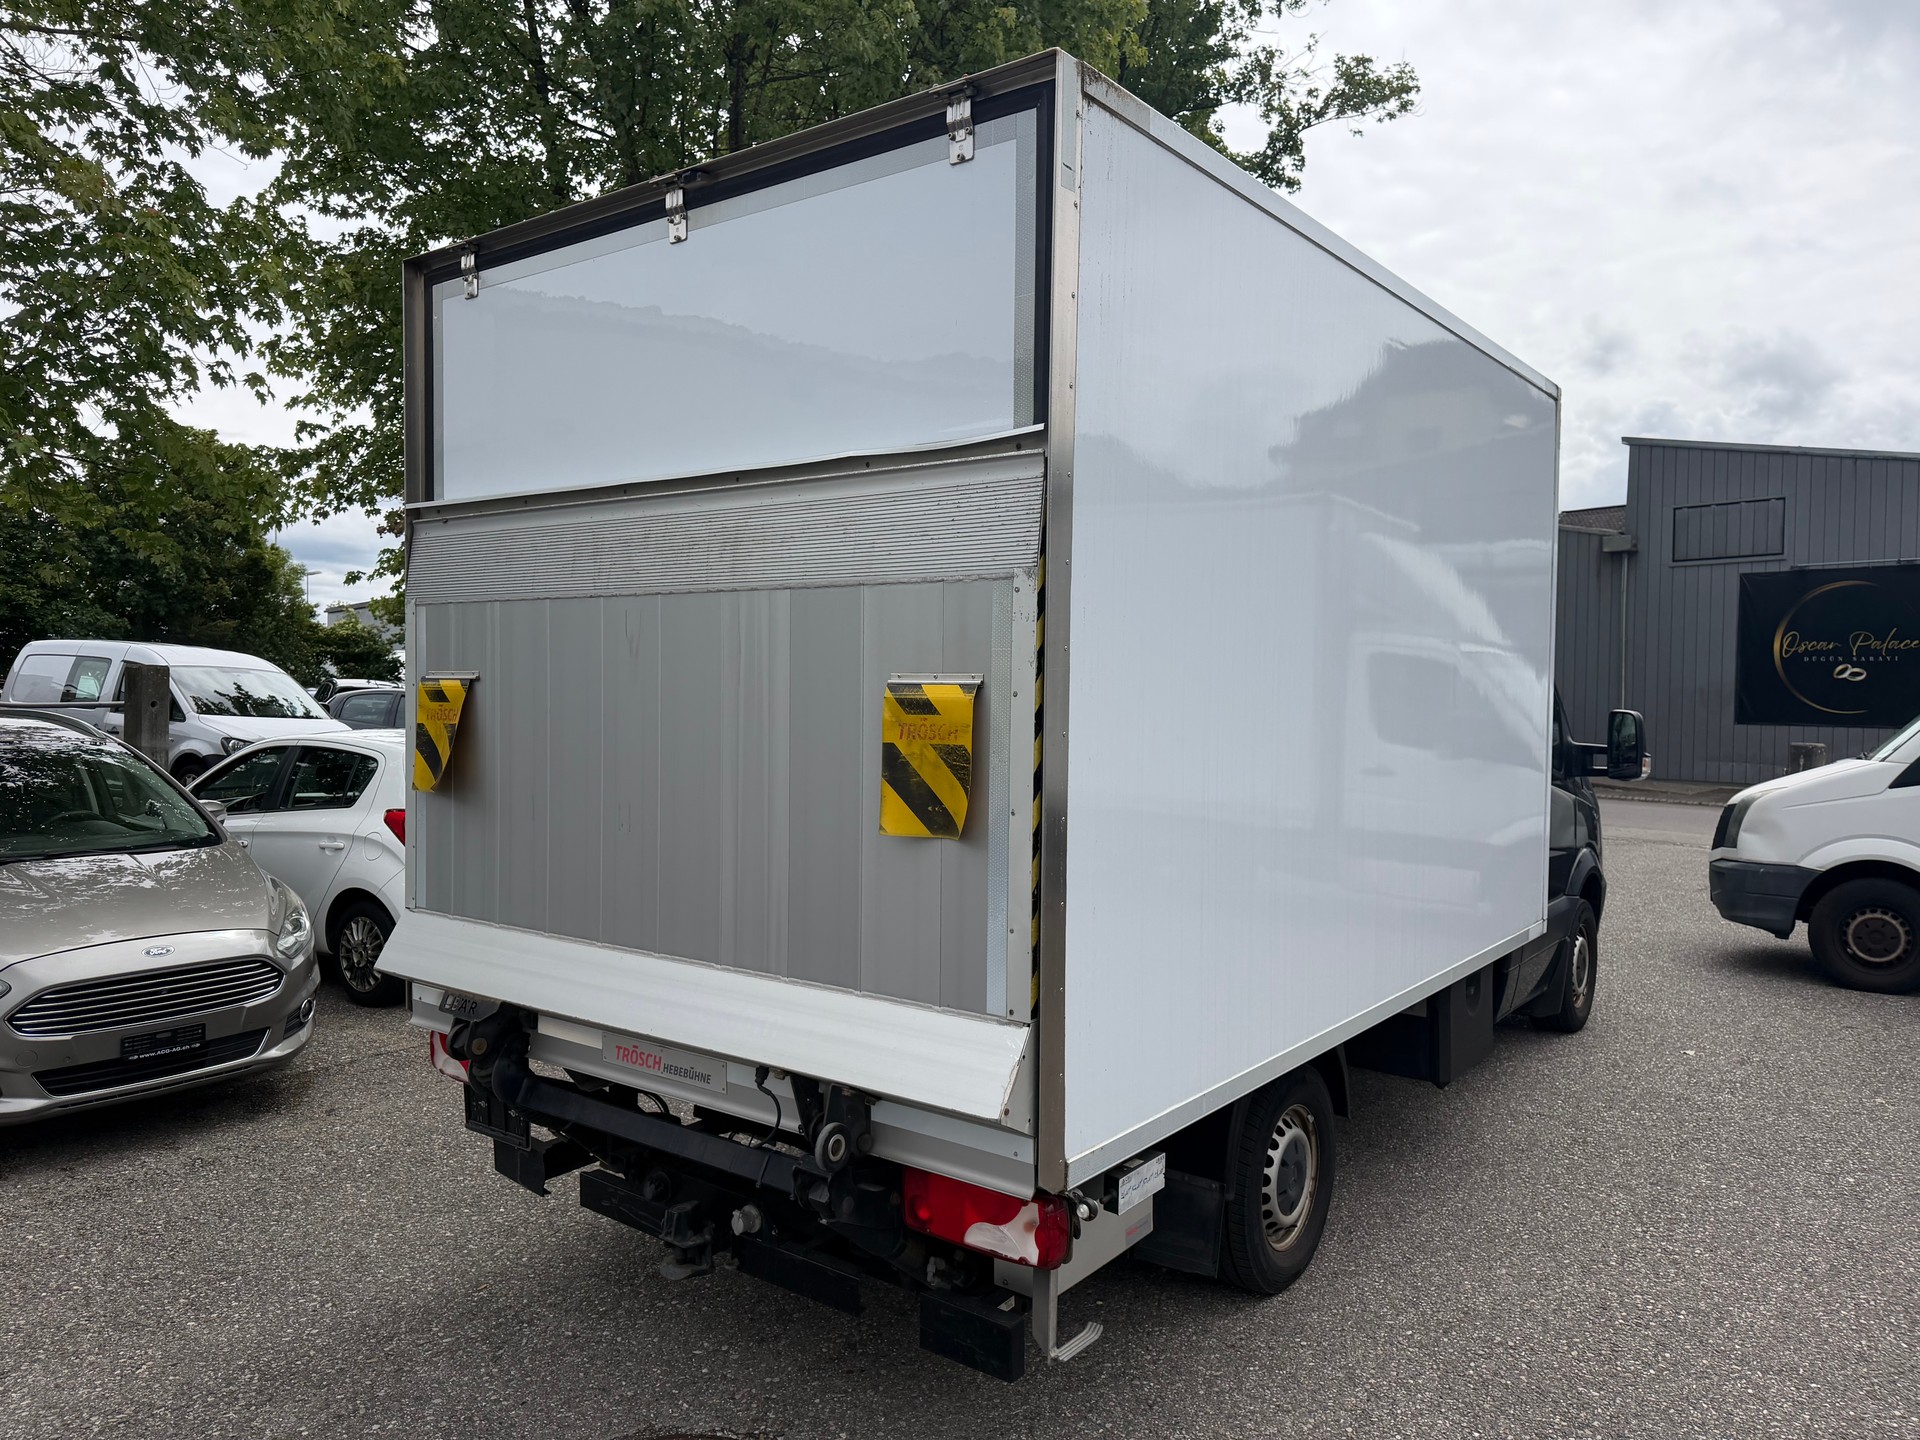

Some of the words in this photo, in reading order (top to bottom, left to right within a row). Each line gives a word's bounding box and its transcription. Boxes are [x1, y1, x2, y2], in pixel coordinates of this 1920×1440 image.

[1782, 631, 1842, 658] Oscar
[1849, 628, 1920, 656] Palace
[898, 717, 960, 742] TRÖSCH
[615, 1044, 662, 1072] TRÖSCH
[662, 1062, 712, 1085] HEBEBÜHNE
